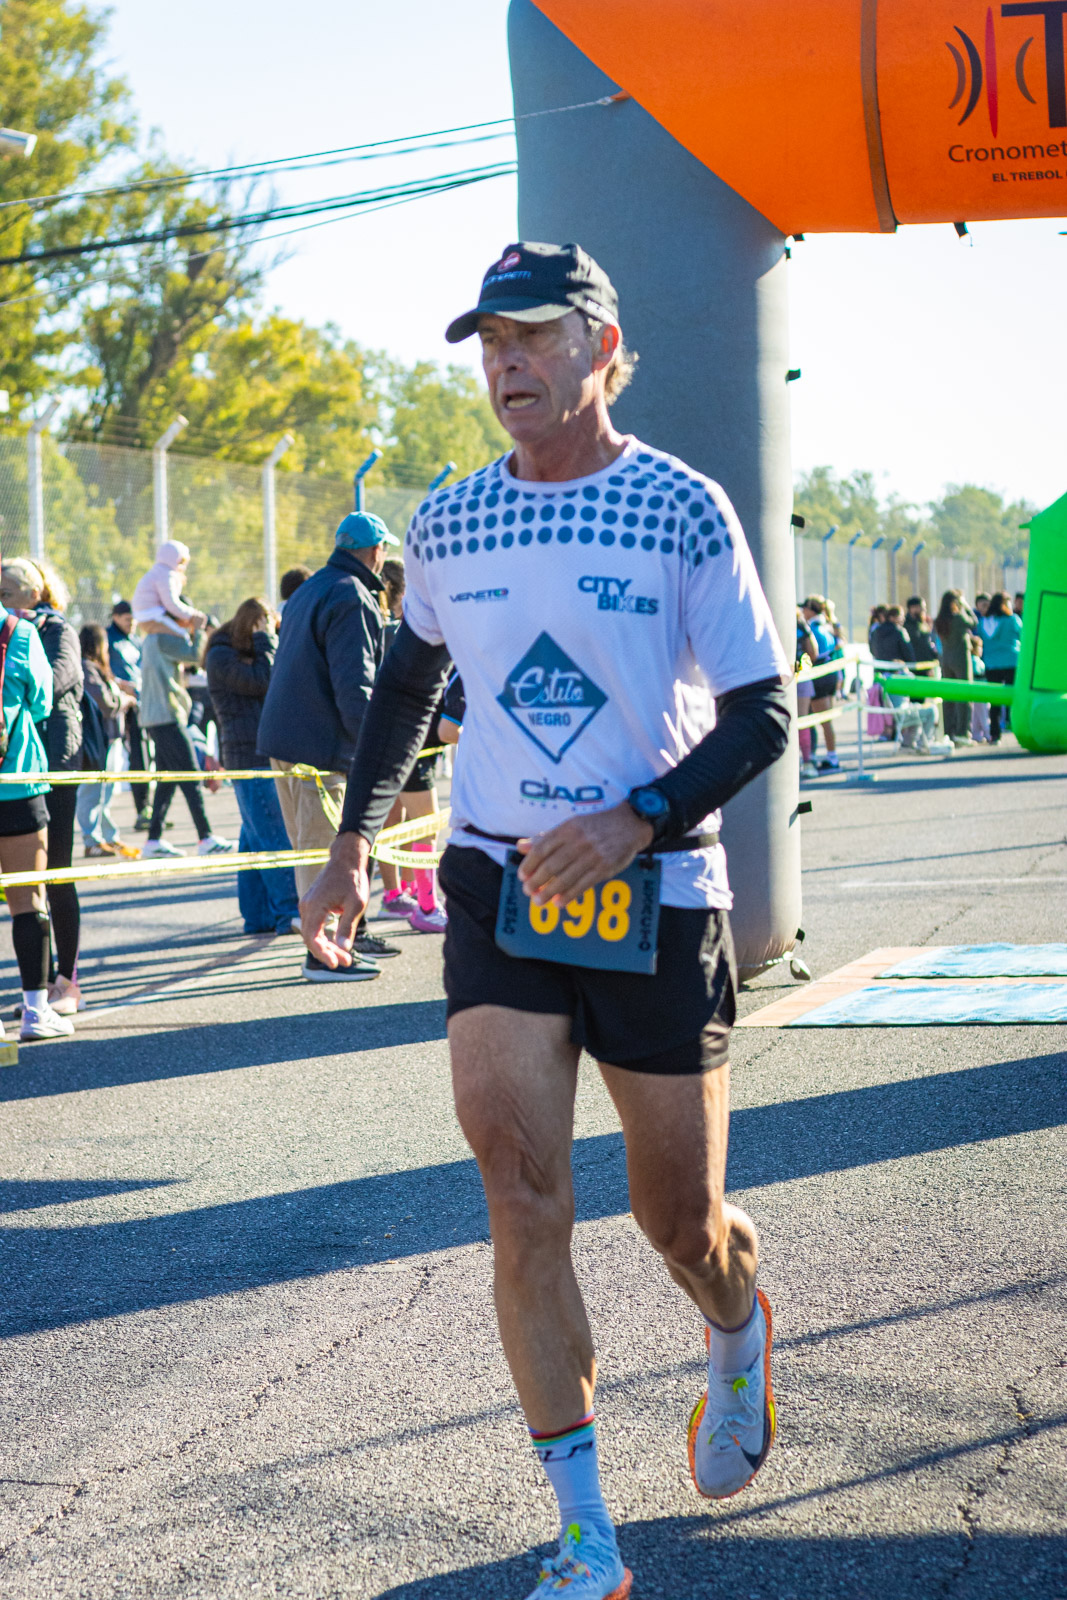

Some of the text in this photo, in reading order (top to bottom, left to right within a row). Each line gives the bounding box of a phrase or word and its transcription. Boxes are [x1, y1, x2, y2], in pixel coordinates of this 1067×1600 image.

[992, 172, 1008, 182] EL
[1010, 169, 1062, 182] TREBOL
[449, 587, 509, 603] VENETO
[578, 575, 632, 597] CITY
[597, 593, 659, 616] BIKES
[529, 877, 632, 942] 698
